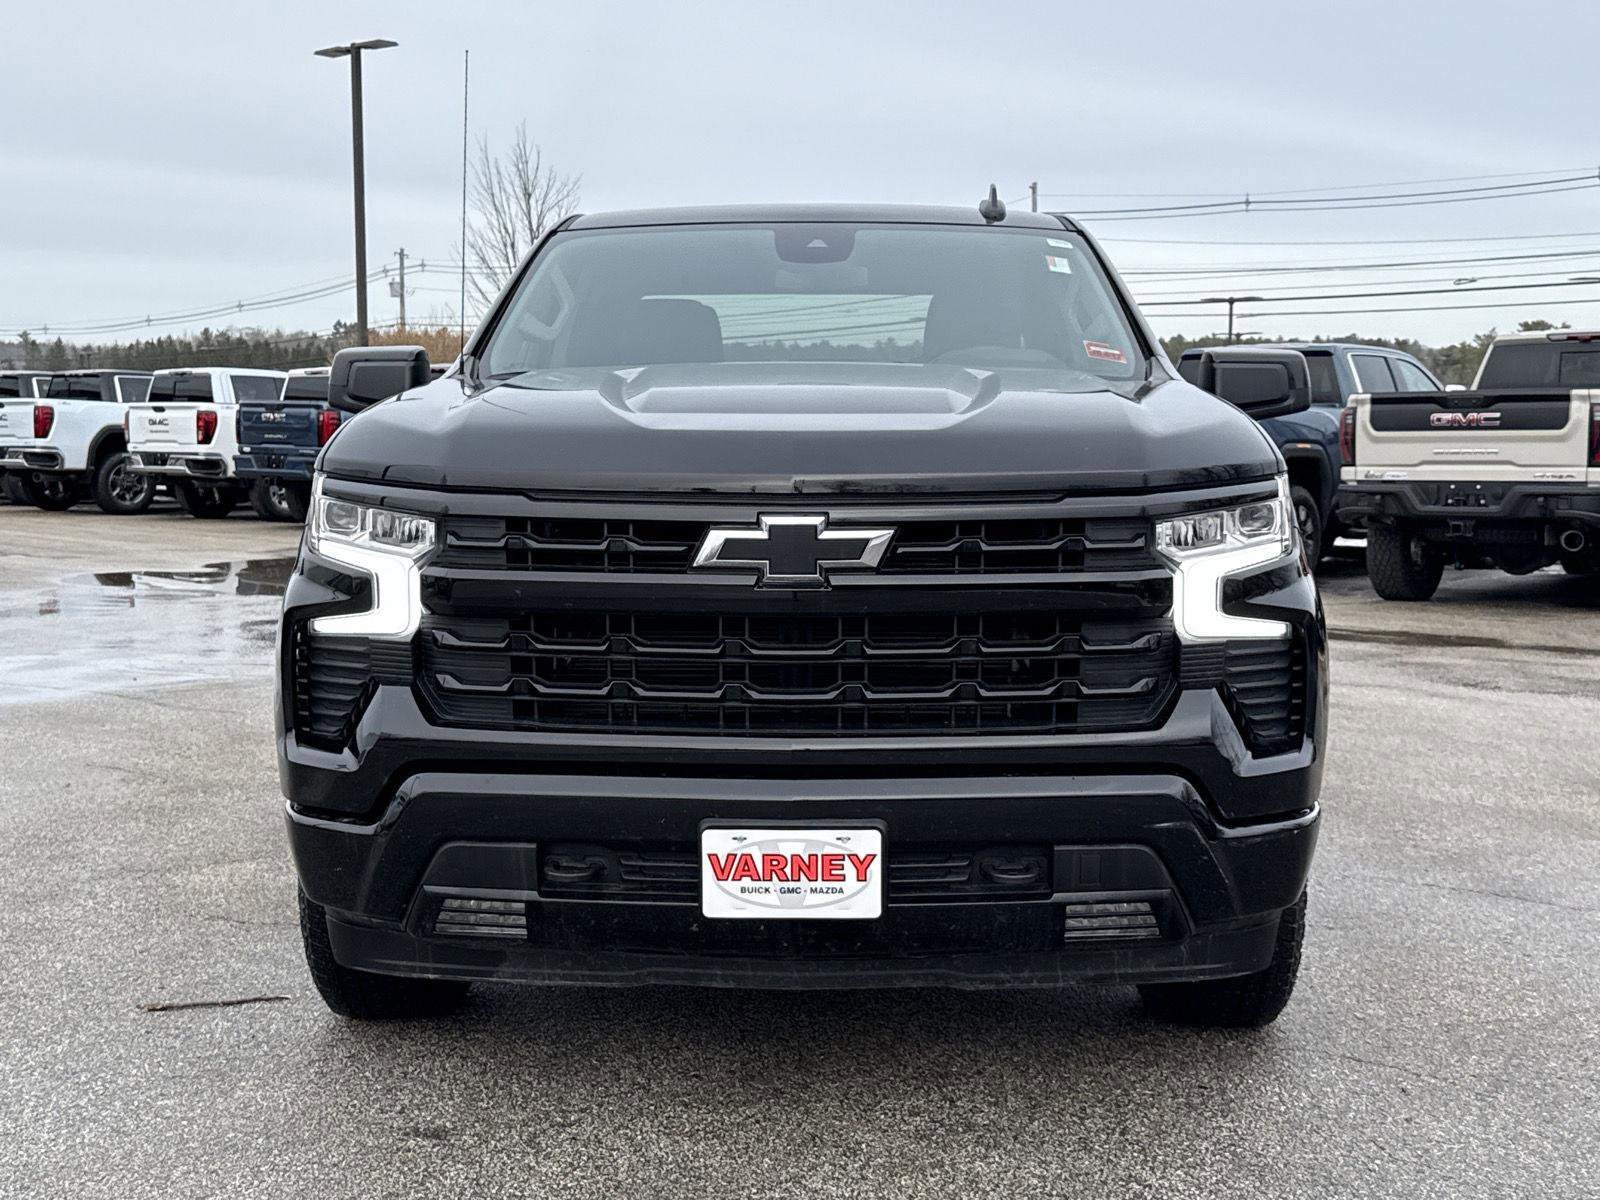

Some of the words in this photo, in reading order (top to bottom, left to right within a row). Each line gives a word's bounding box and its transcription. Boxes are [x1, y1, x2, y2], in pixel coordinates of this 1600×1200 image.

[1430, 412, 1501, 427] GMC
[707, 853, 877, 882] VARNEY
[740, 886, 771, 895] BUICK
[779, 886, 802, 895] GMC
[809, 886, 845, 895] MAZDA
